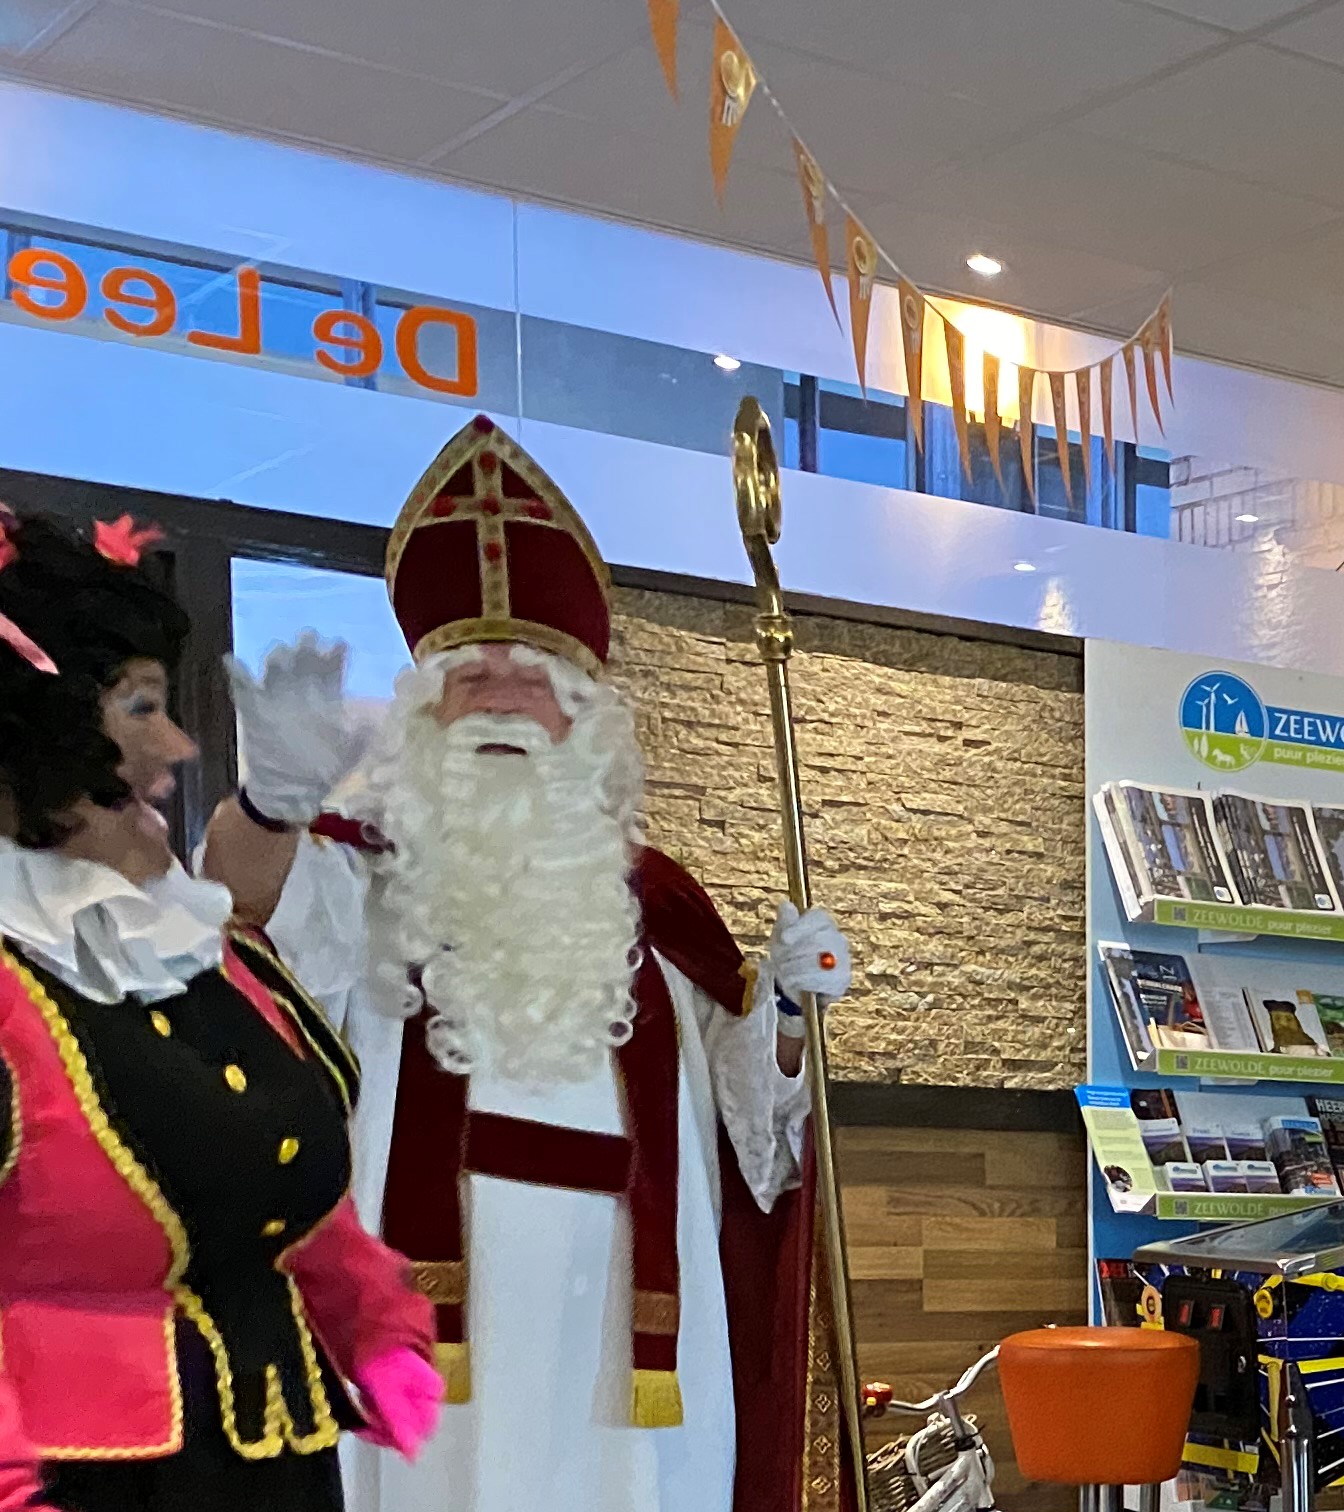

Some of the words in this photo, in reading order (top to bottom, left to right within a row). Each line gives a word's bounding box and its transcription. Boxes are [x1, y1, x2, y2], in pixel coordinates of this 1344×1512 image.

[1273, 747, 1304, 760] puur
[1192, 909, 1264, 929] ZEEWOLDE
[1267, 920, 1293, 931] puur
[1194, 1057, 1266, 1075] ZEEWOLDE
[1194, 1201, 1264, 1216] ZEEWOLDE
